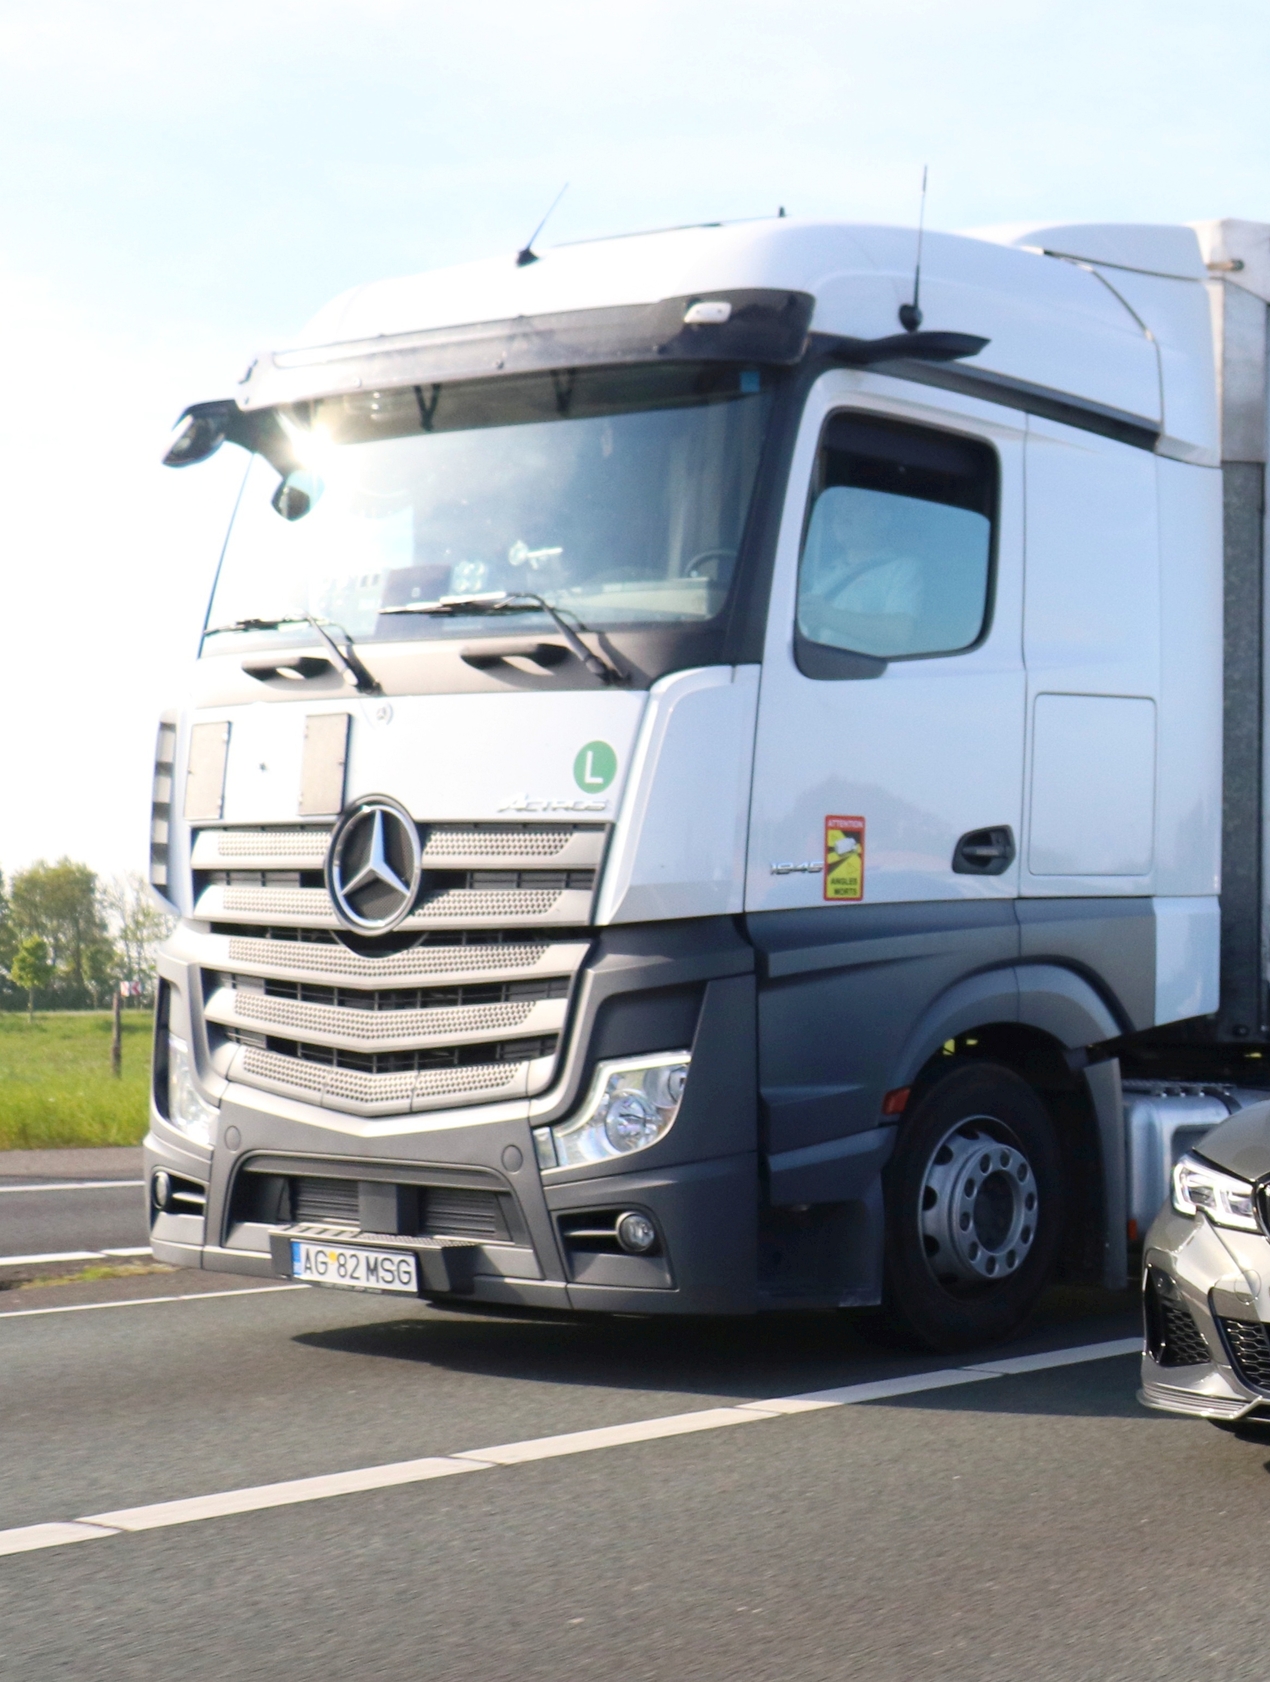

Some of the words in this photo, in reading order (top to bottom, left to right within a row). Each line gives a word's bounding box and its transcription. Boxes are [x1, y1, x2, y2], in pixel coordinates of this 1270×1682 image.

[584, 750, 604, 784] L
[303, 1248, 329, 1276] AG
[337, 1252, 360, 1280] 82
[365, 1255, 412, 1285] MSG
